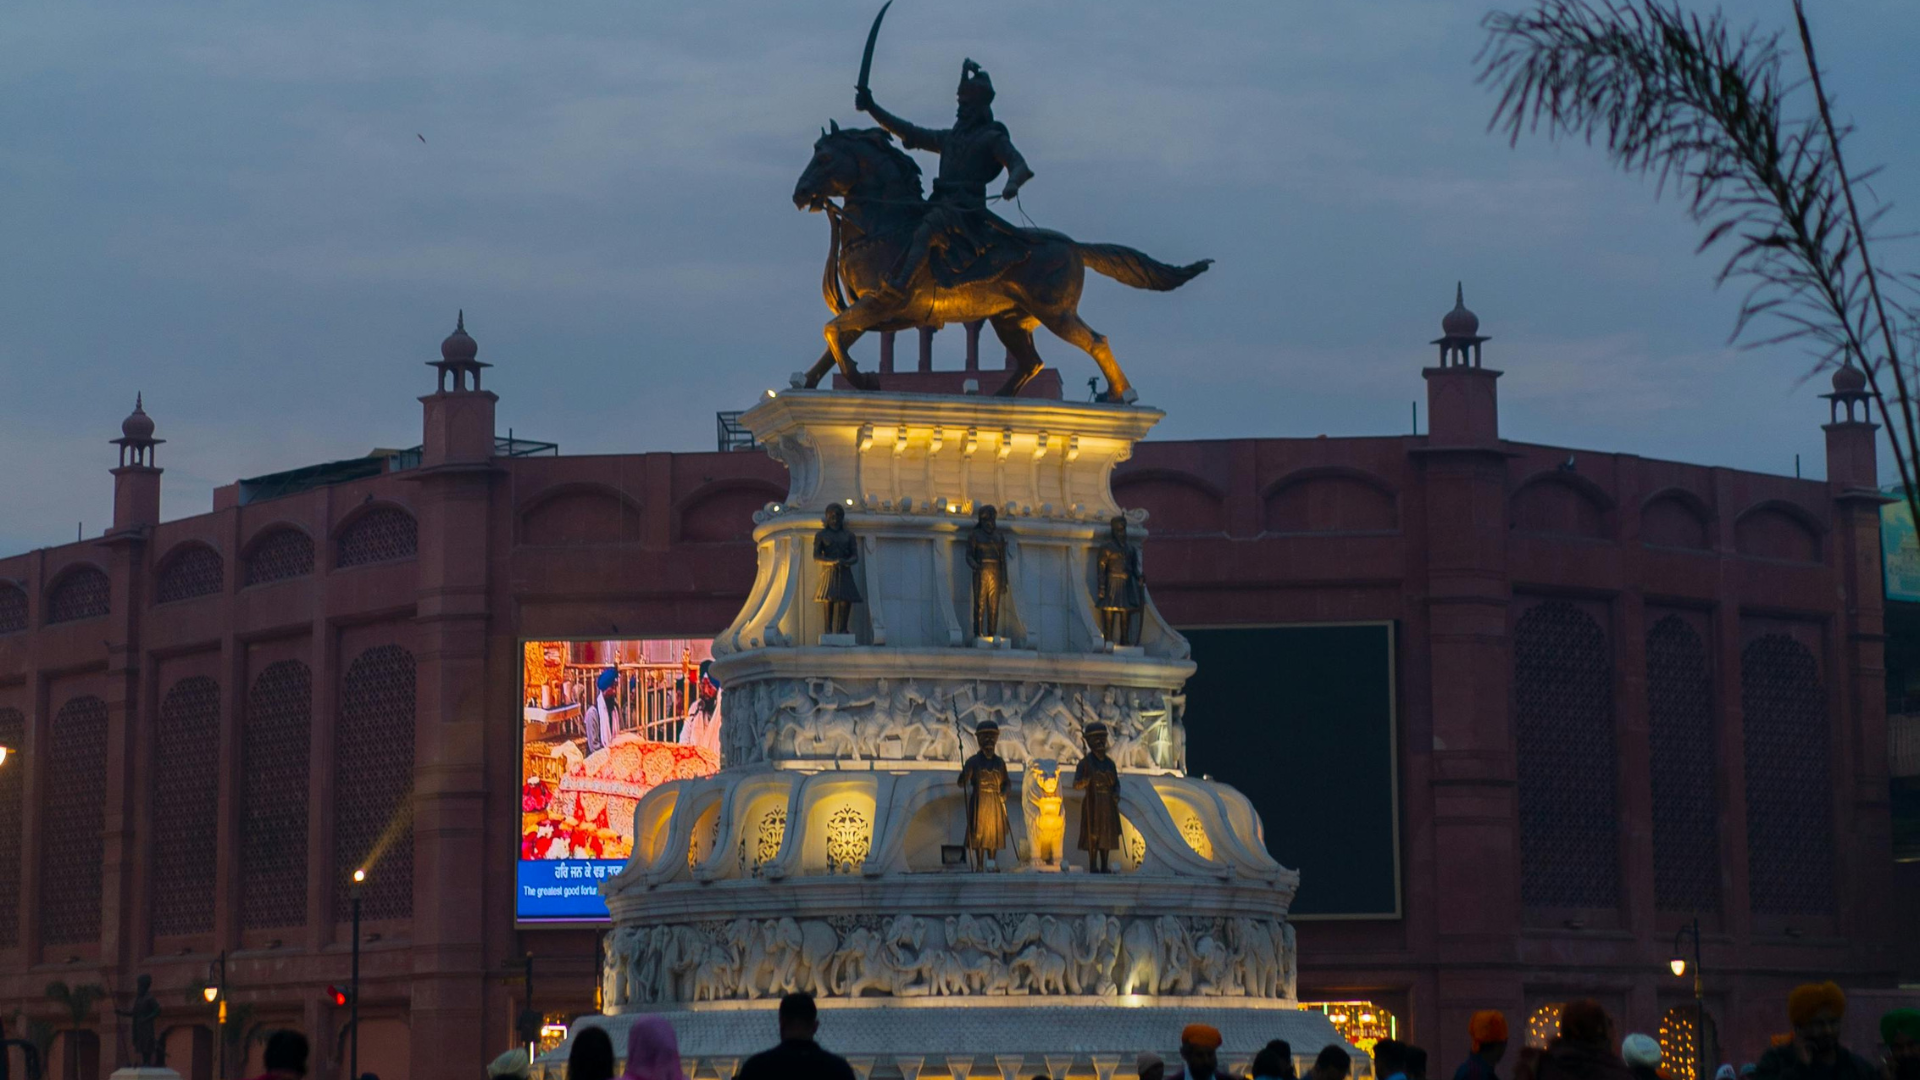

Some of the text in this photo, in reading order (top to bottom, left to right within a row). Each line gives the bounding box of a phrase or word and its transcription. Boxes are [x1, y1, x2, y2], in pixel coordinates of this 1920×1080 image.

[570, 865, 583, 878] ਜਨ
[584, 861, 592, 878] ਕੇ
[523, 885, 536, 896] The
[537, 886, 563, 898] greatest
[563, 885, 580, 898] good
